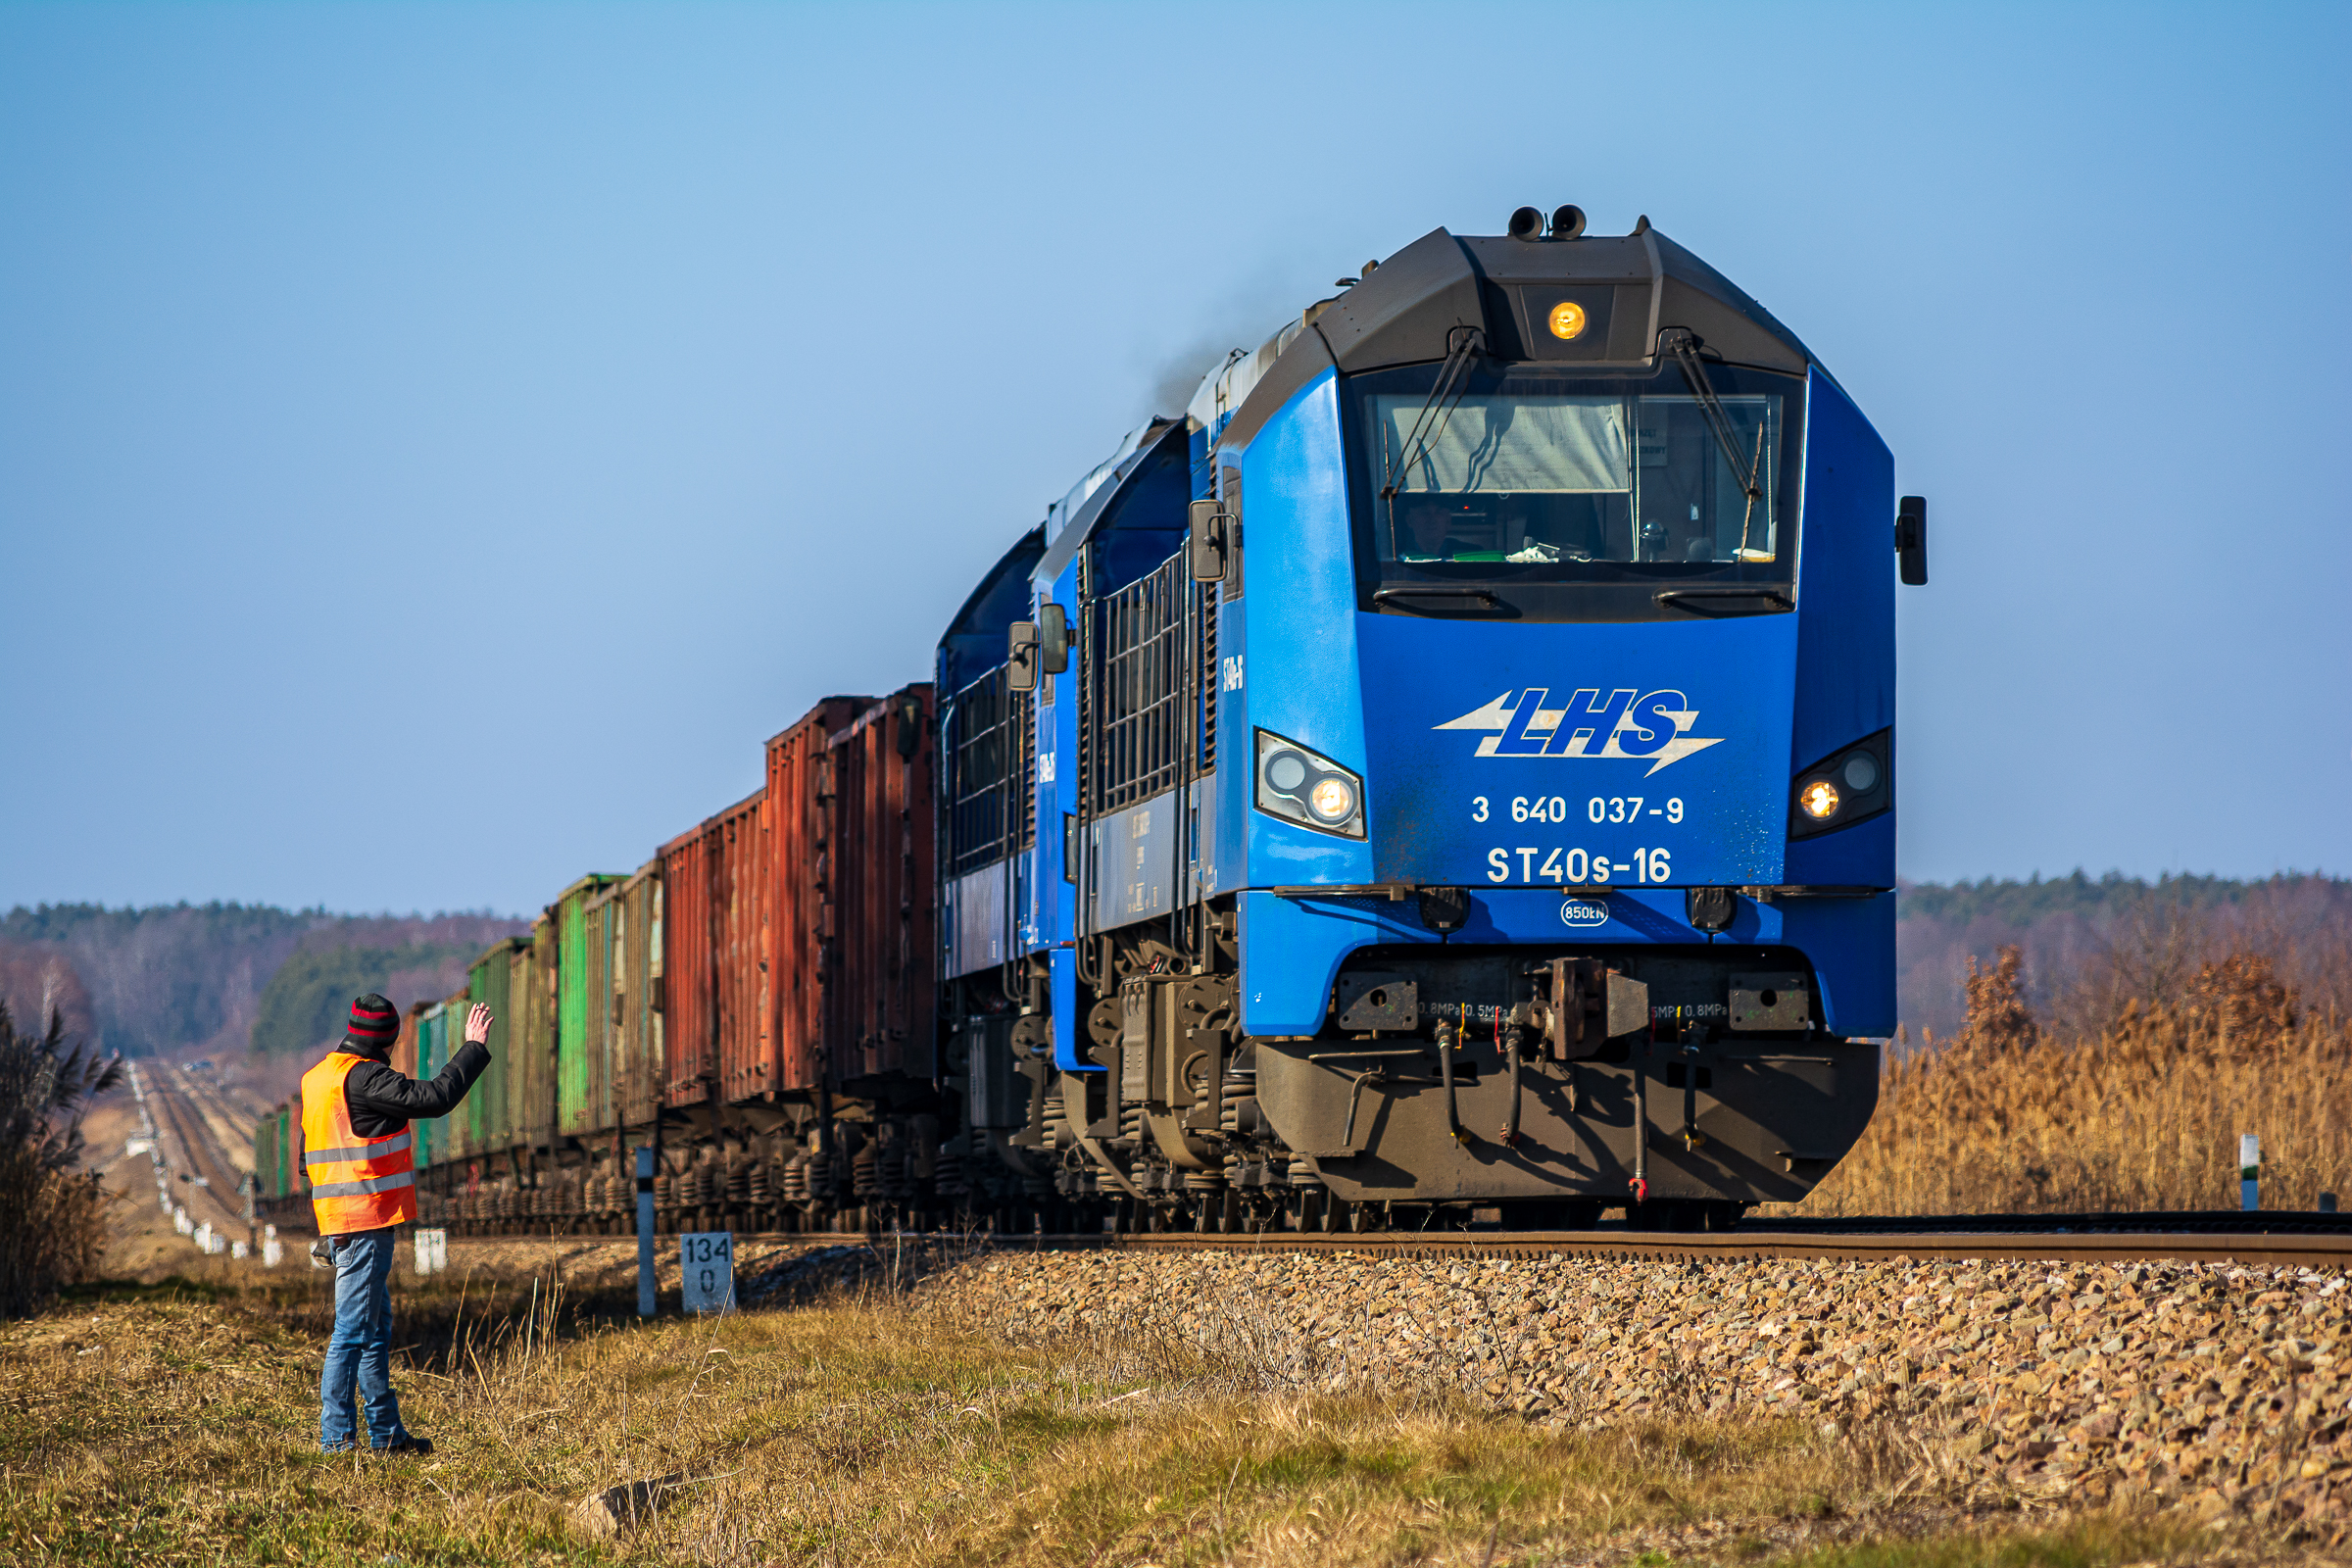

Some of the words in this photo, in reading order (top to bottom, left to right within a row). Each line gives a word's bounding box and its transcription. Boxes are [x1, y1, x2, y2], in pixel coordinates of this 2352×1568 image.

[1493, 687, 1688, 757] LHS
[1471, 796, 1490, 823] 3
[1511, 796, 1567, 823] 640
[1588, 797, 1685, 824] 037-9
[1487, 847, 1672, 884] ST40s-16
[1565, 906, 1605, 919] 850kN
[1417, 1002, 1461, 1016] 0.8MPa
[1685, 1004, 1728, 1017] 0.8MPa
[686, 1237, 729, 1263] 134
[700, 1268, 715, 1294] 0
